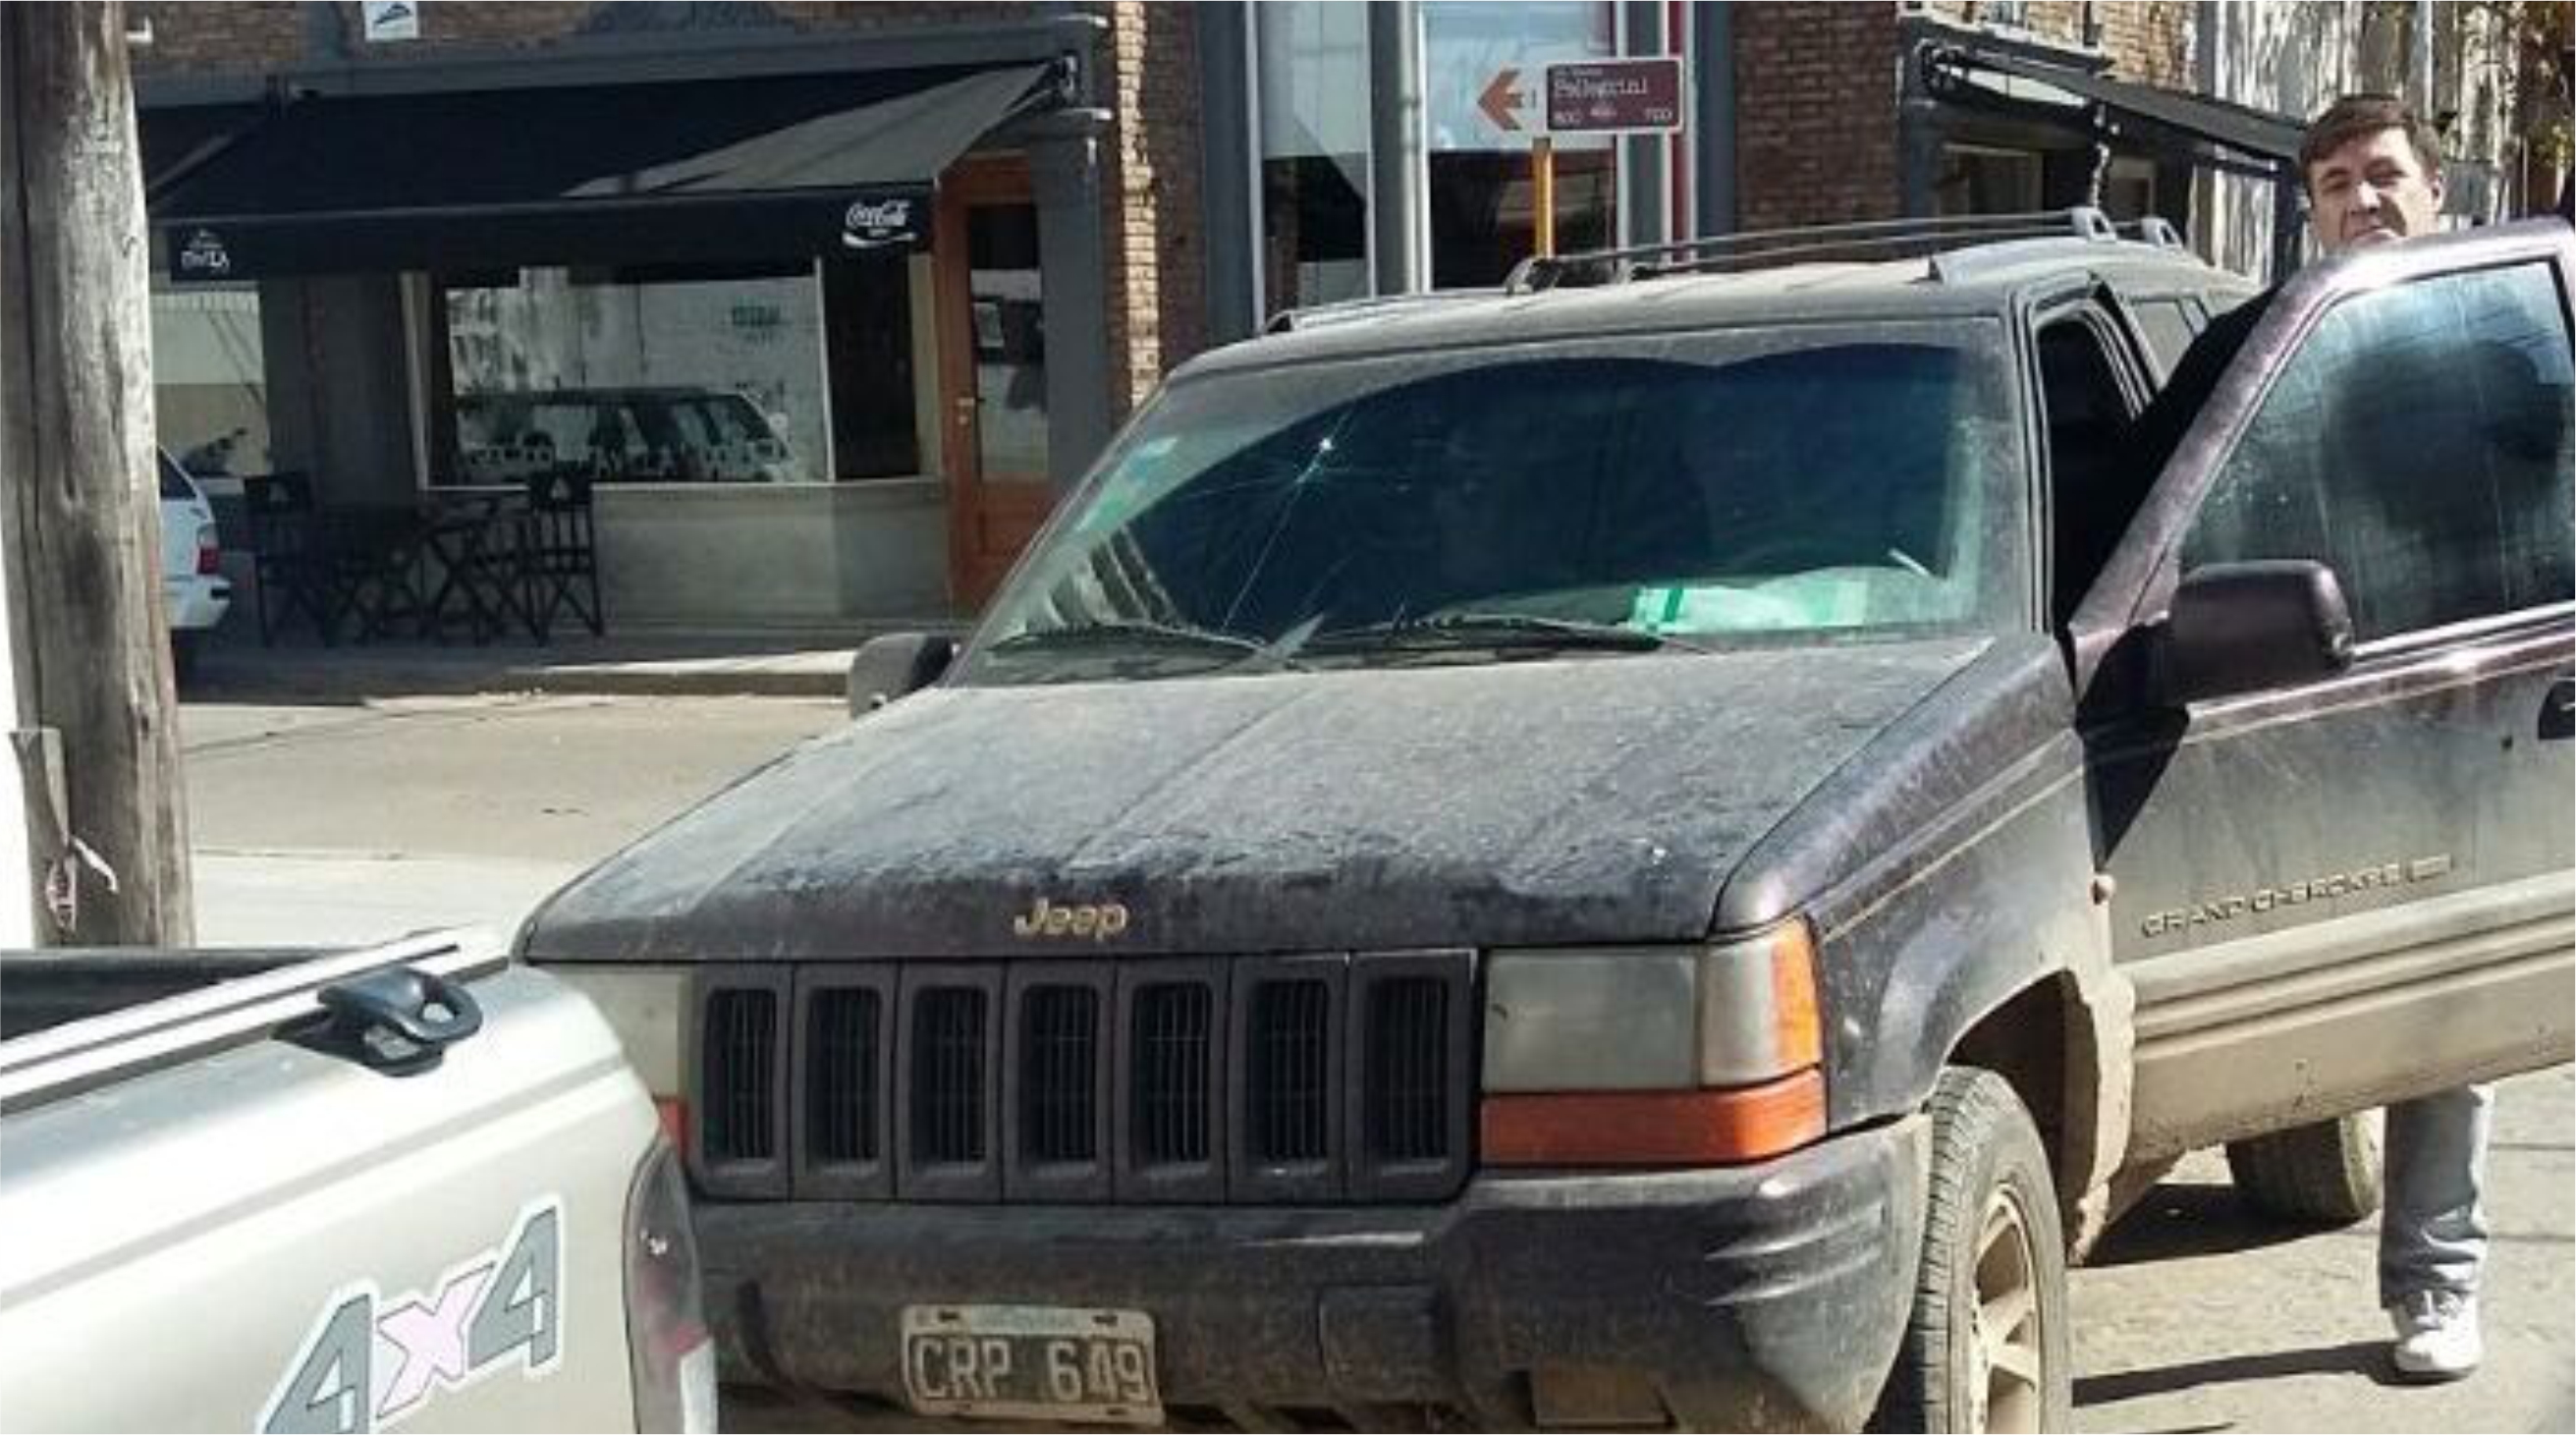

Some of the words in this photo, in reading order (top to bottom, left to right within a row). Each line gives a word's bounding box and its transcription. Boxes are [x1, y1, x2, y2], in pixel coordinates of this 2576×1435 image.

[1554, 77, 1648, 100] Pellegrini
[1014, 896, 1127, 942] Jeep
[914, 1337, 1012, 1399] CRP
[1047, 1339, 1149, 1403] 649
